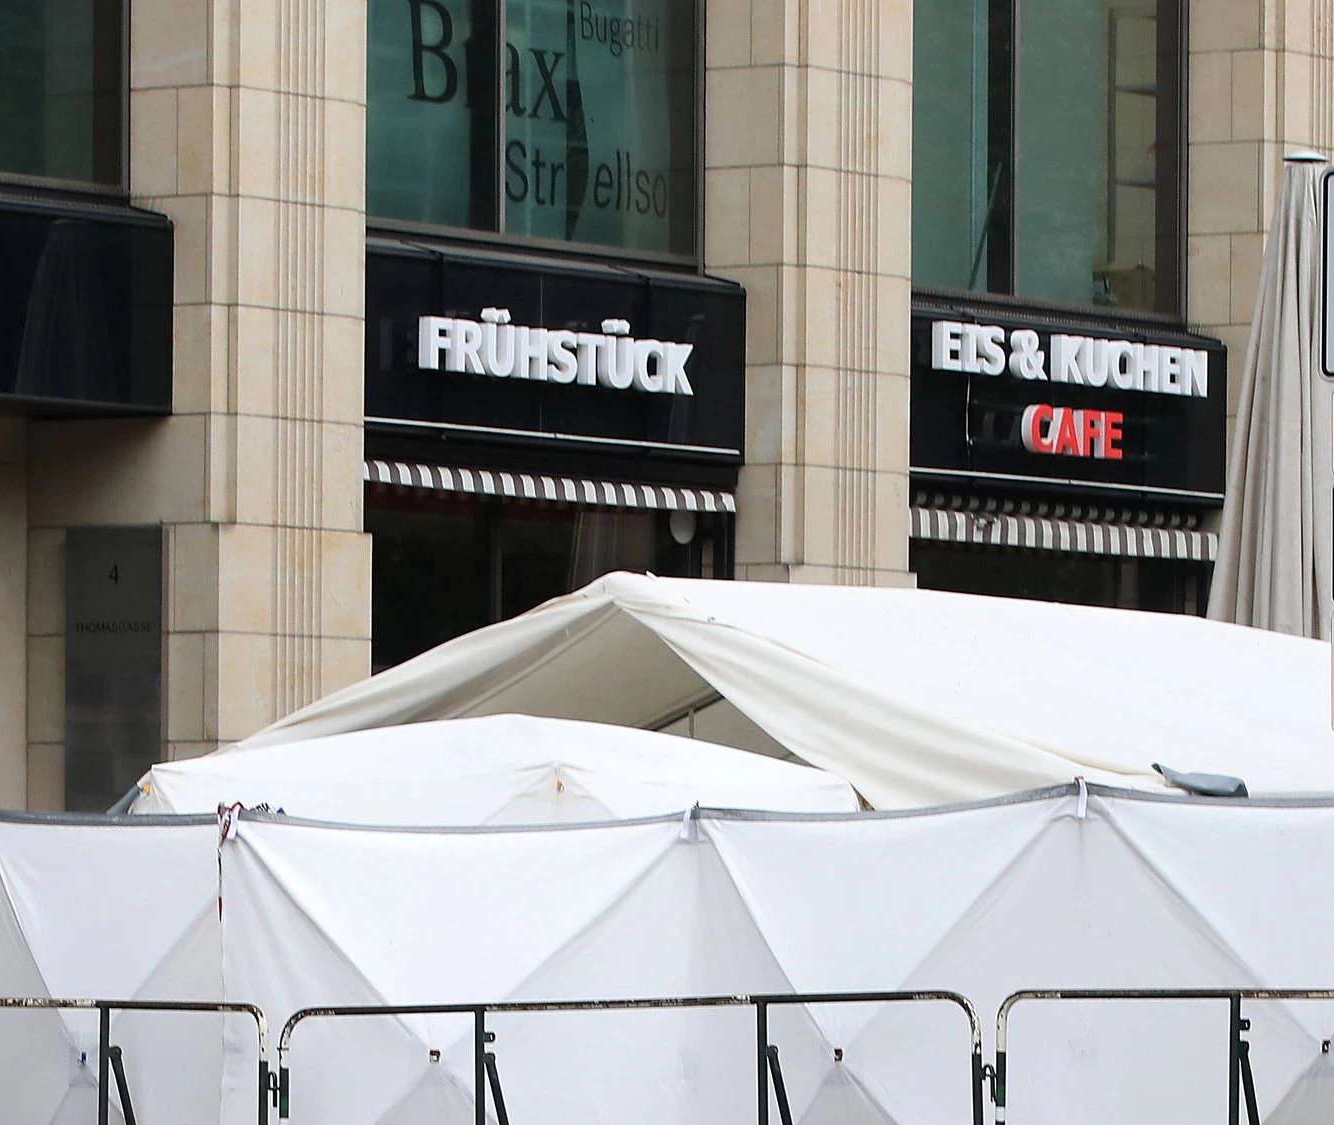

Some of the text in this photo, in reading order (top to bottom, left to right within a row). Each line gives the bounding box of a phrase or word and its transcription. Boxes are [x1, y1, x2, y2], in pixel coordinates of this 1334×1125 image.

[579, 2, 659, 56] Bugatti
[418, 307, 693, 395] FRÜHSTÜCK
[932, 320, 1208, 398] EIS & KUCHEN
[1021, 403, 1124, 460] CAFE
[108, 564, 119, 584] 4
